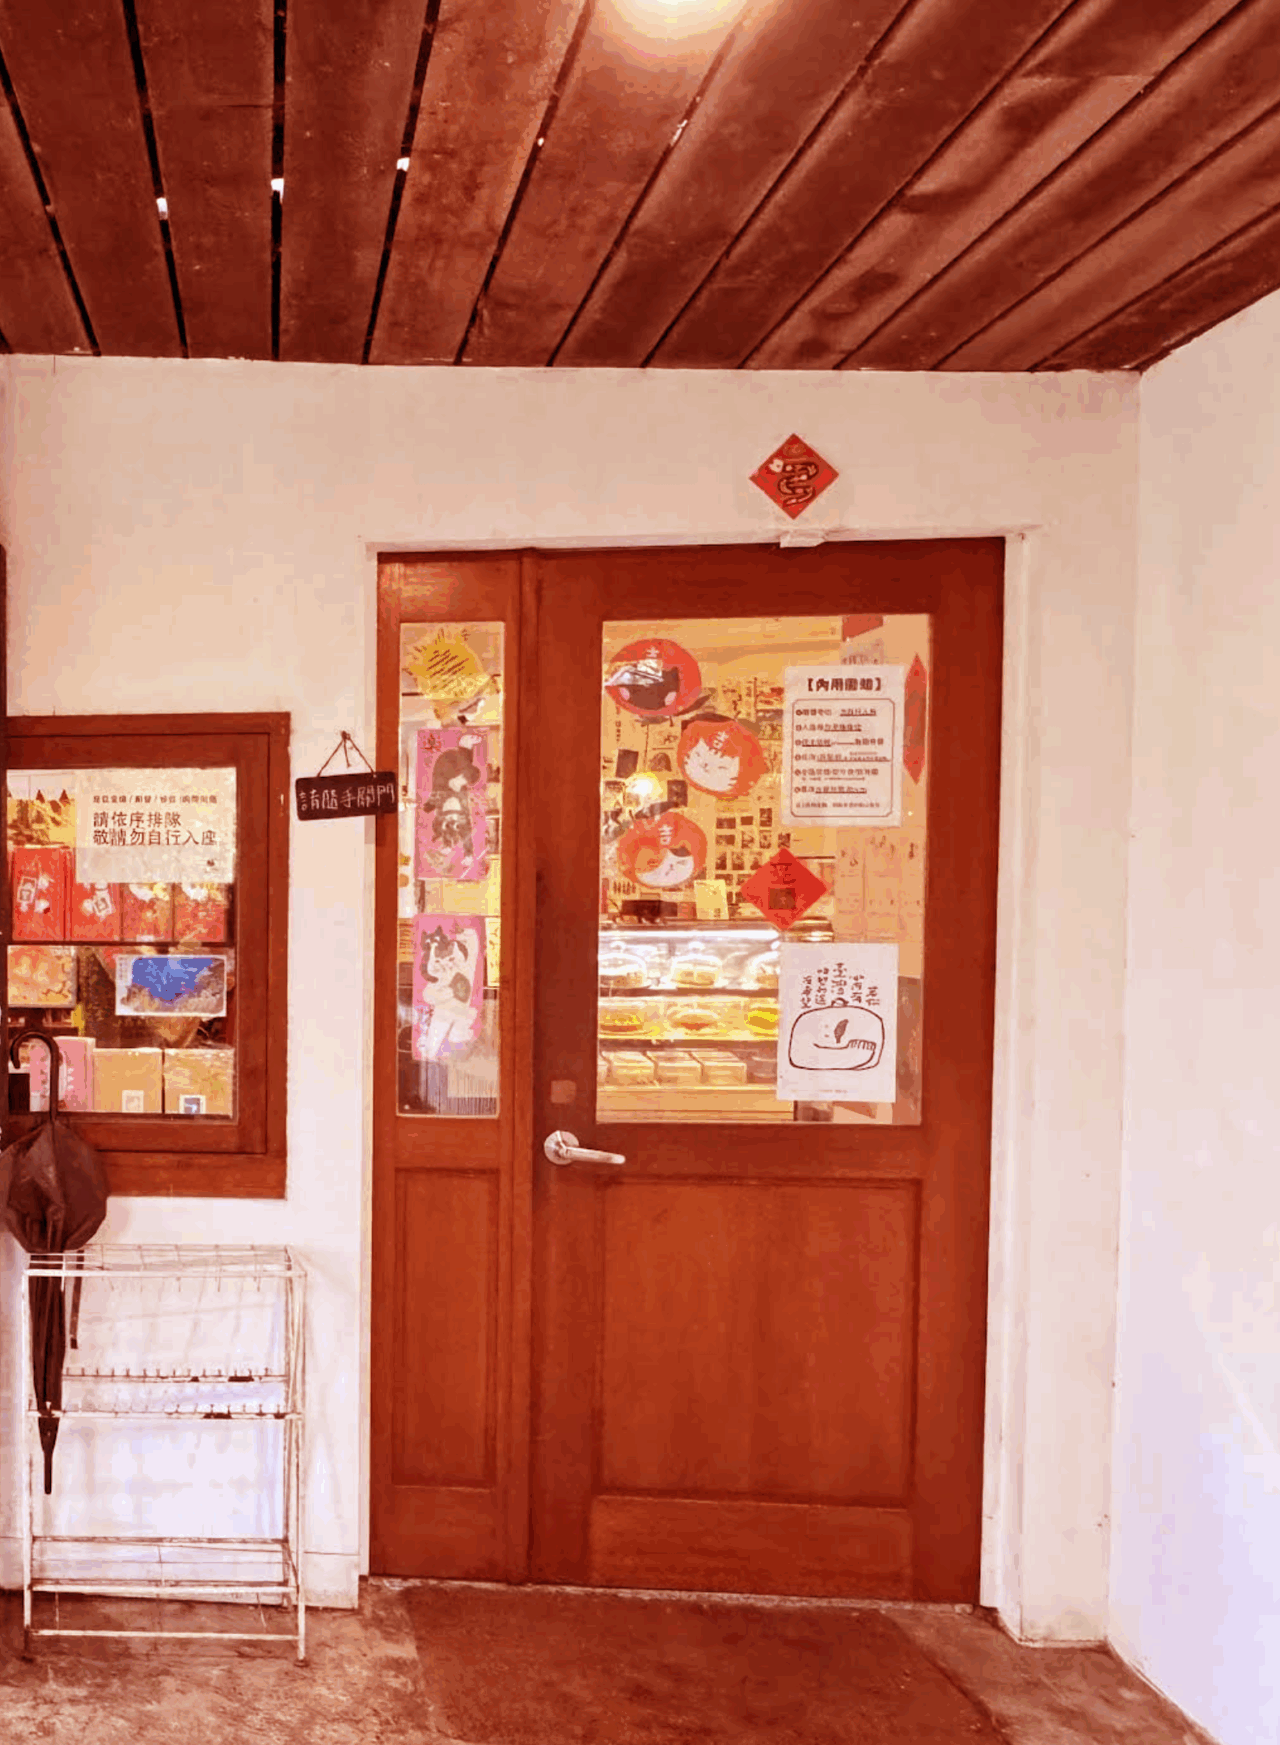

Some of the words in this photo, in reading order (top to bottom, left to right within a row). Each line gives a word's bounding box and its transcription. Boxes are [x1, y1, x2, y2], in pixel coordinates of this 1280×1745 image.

[93, 811, 181, 828] 請依序排隊
[93, 828, 217, 846] 敬請勿自行入座
